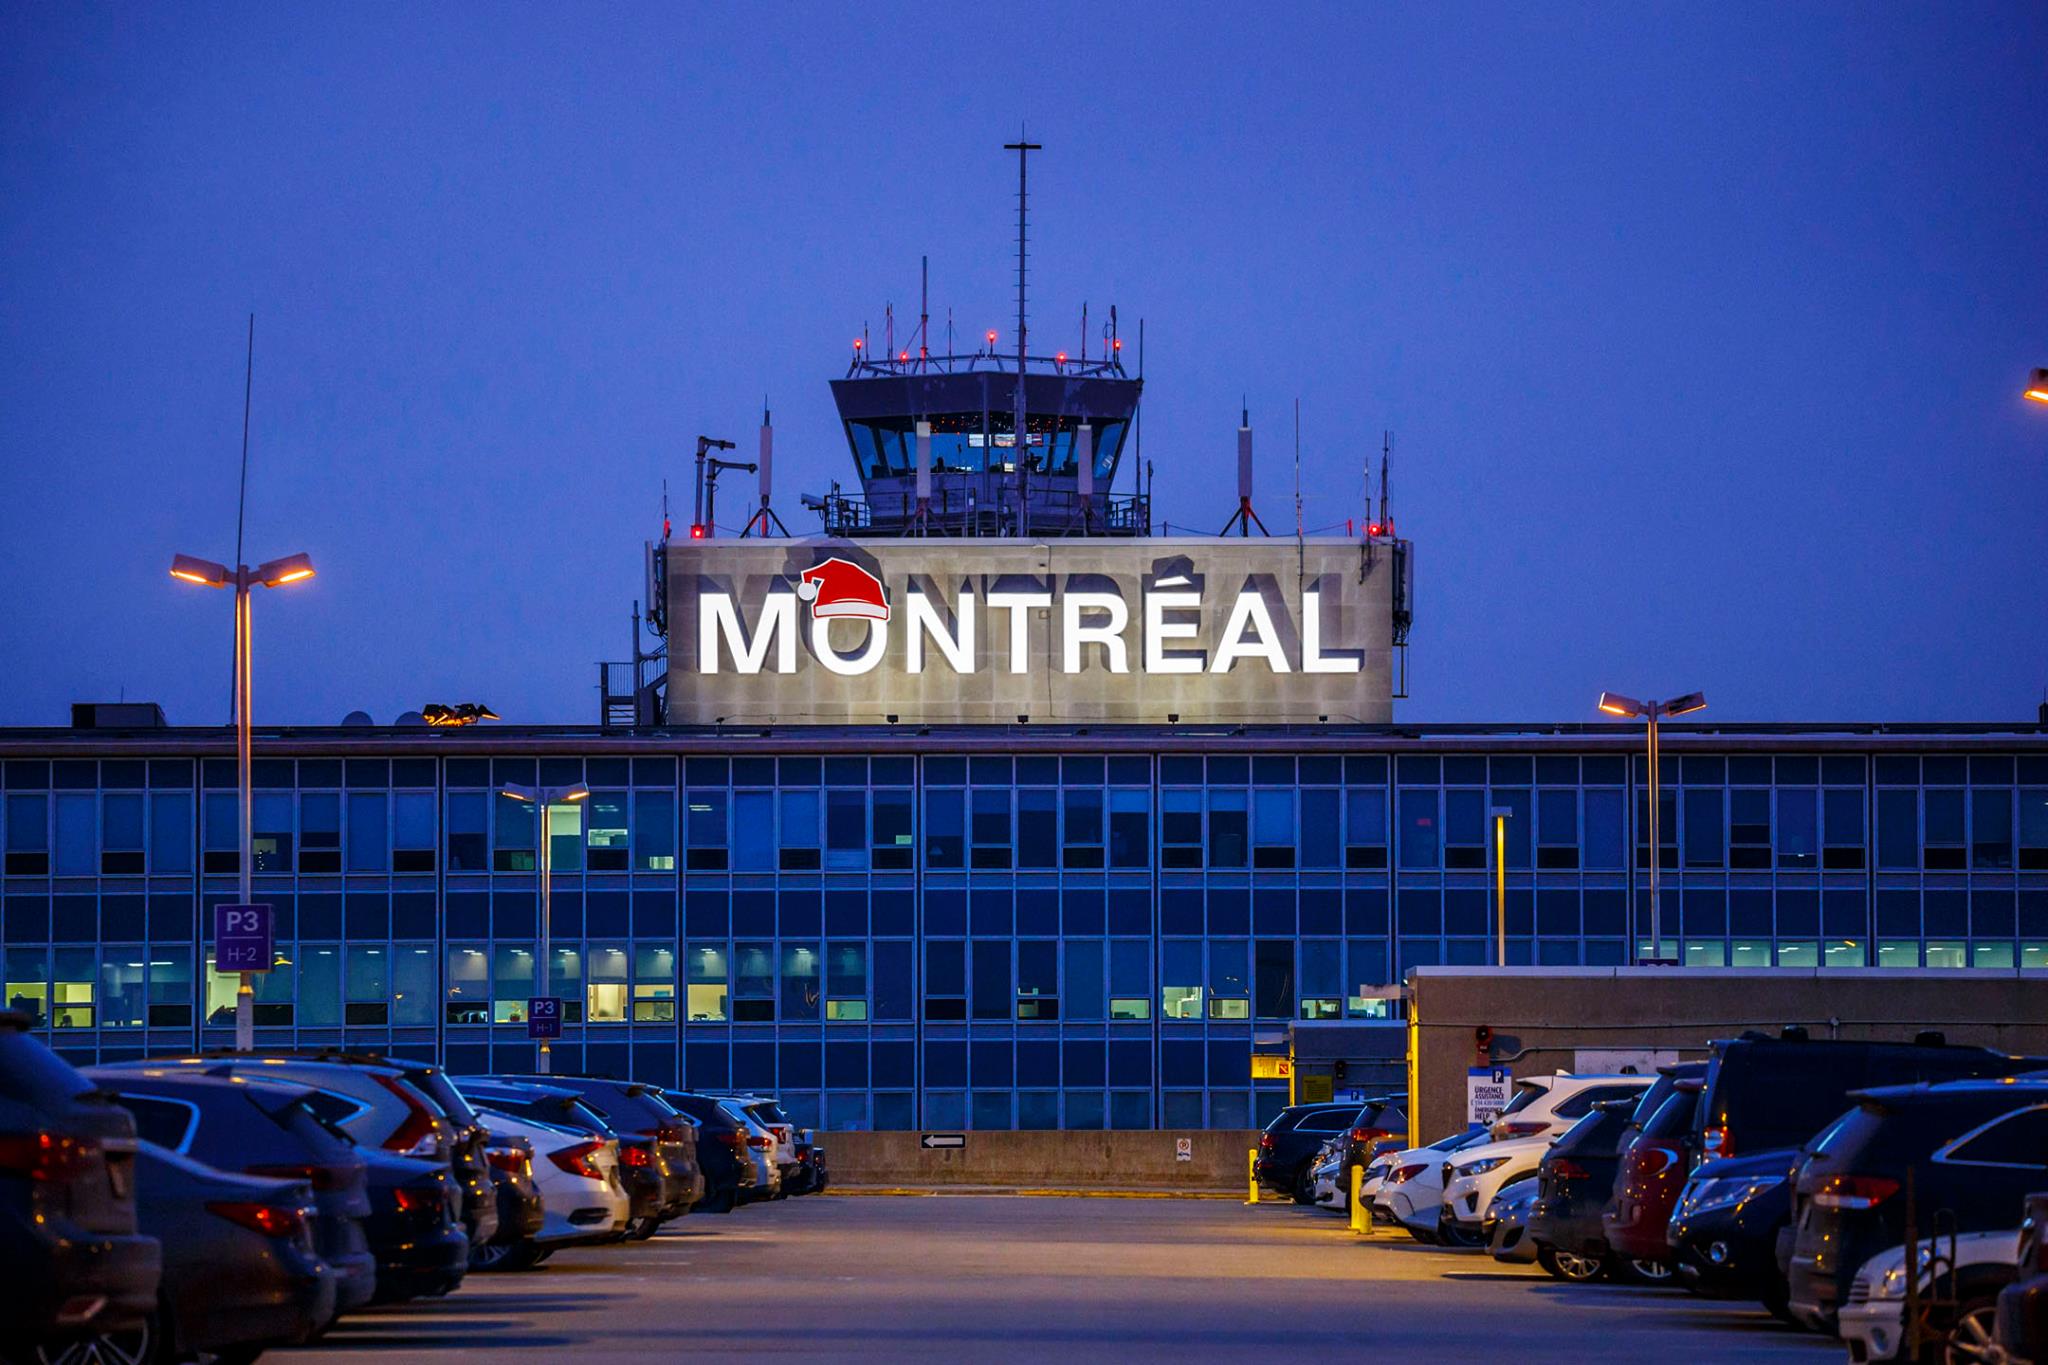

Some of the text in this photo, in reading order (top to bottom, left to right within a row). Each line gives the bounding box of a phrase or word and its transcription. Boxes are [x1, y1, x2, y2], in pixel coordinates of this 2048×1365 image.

[700, 575, 1360, 676] MONTRÉAL
[226, 911, 259, 932] P3
[227, 947, 257, 962] H-2
[534, 1001, 554, 1014] P3
[1495, 1071, 1502, 1083] P
[1474, 1086, 1503, 1094] URGENCE
[1474, 1112, 1491, 1121] HELP
